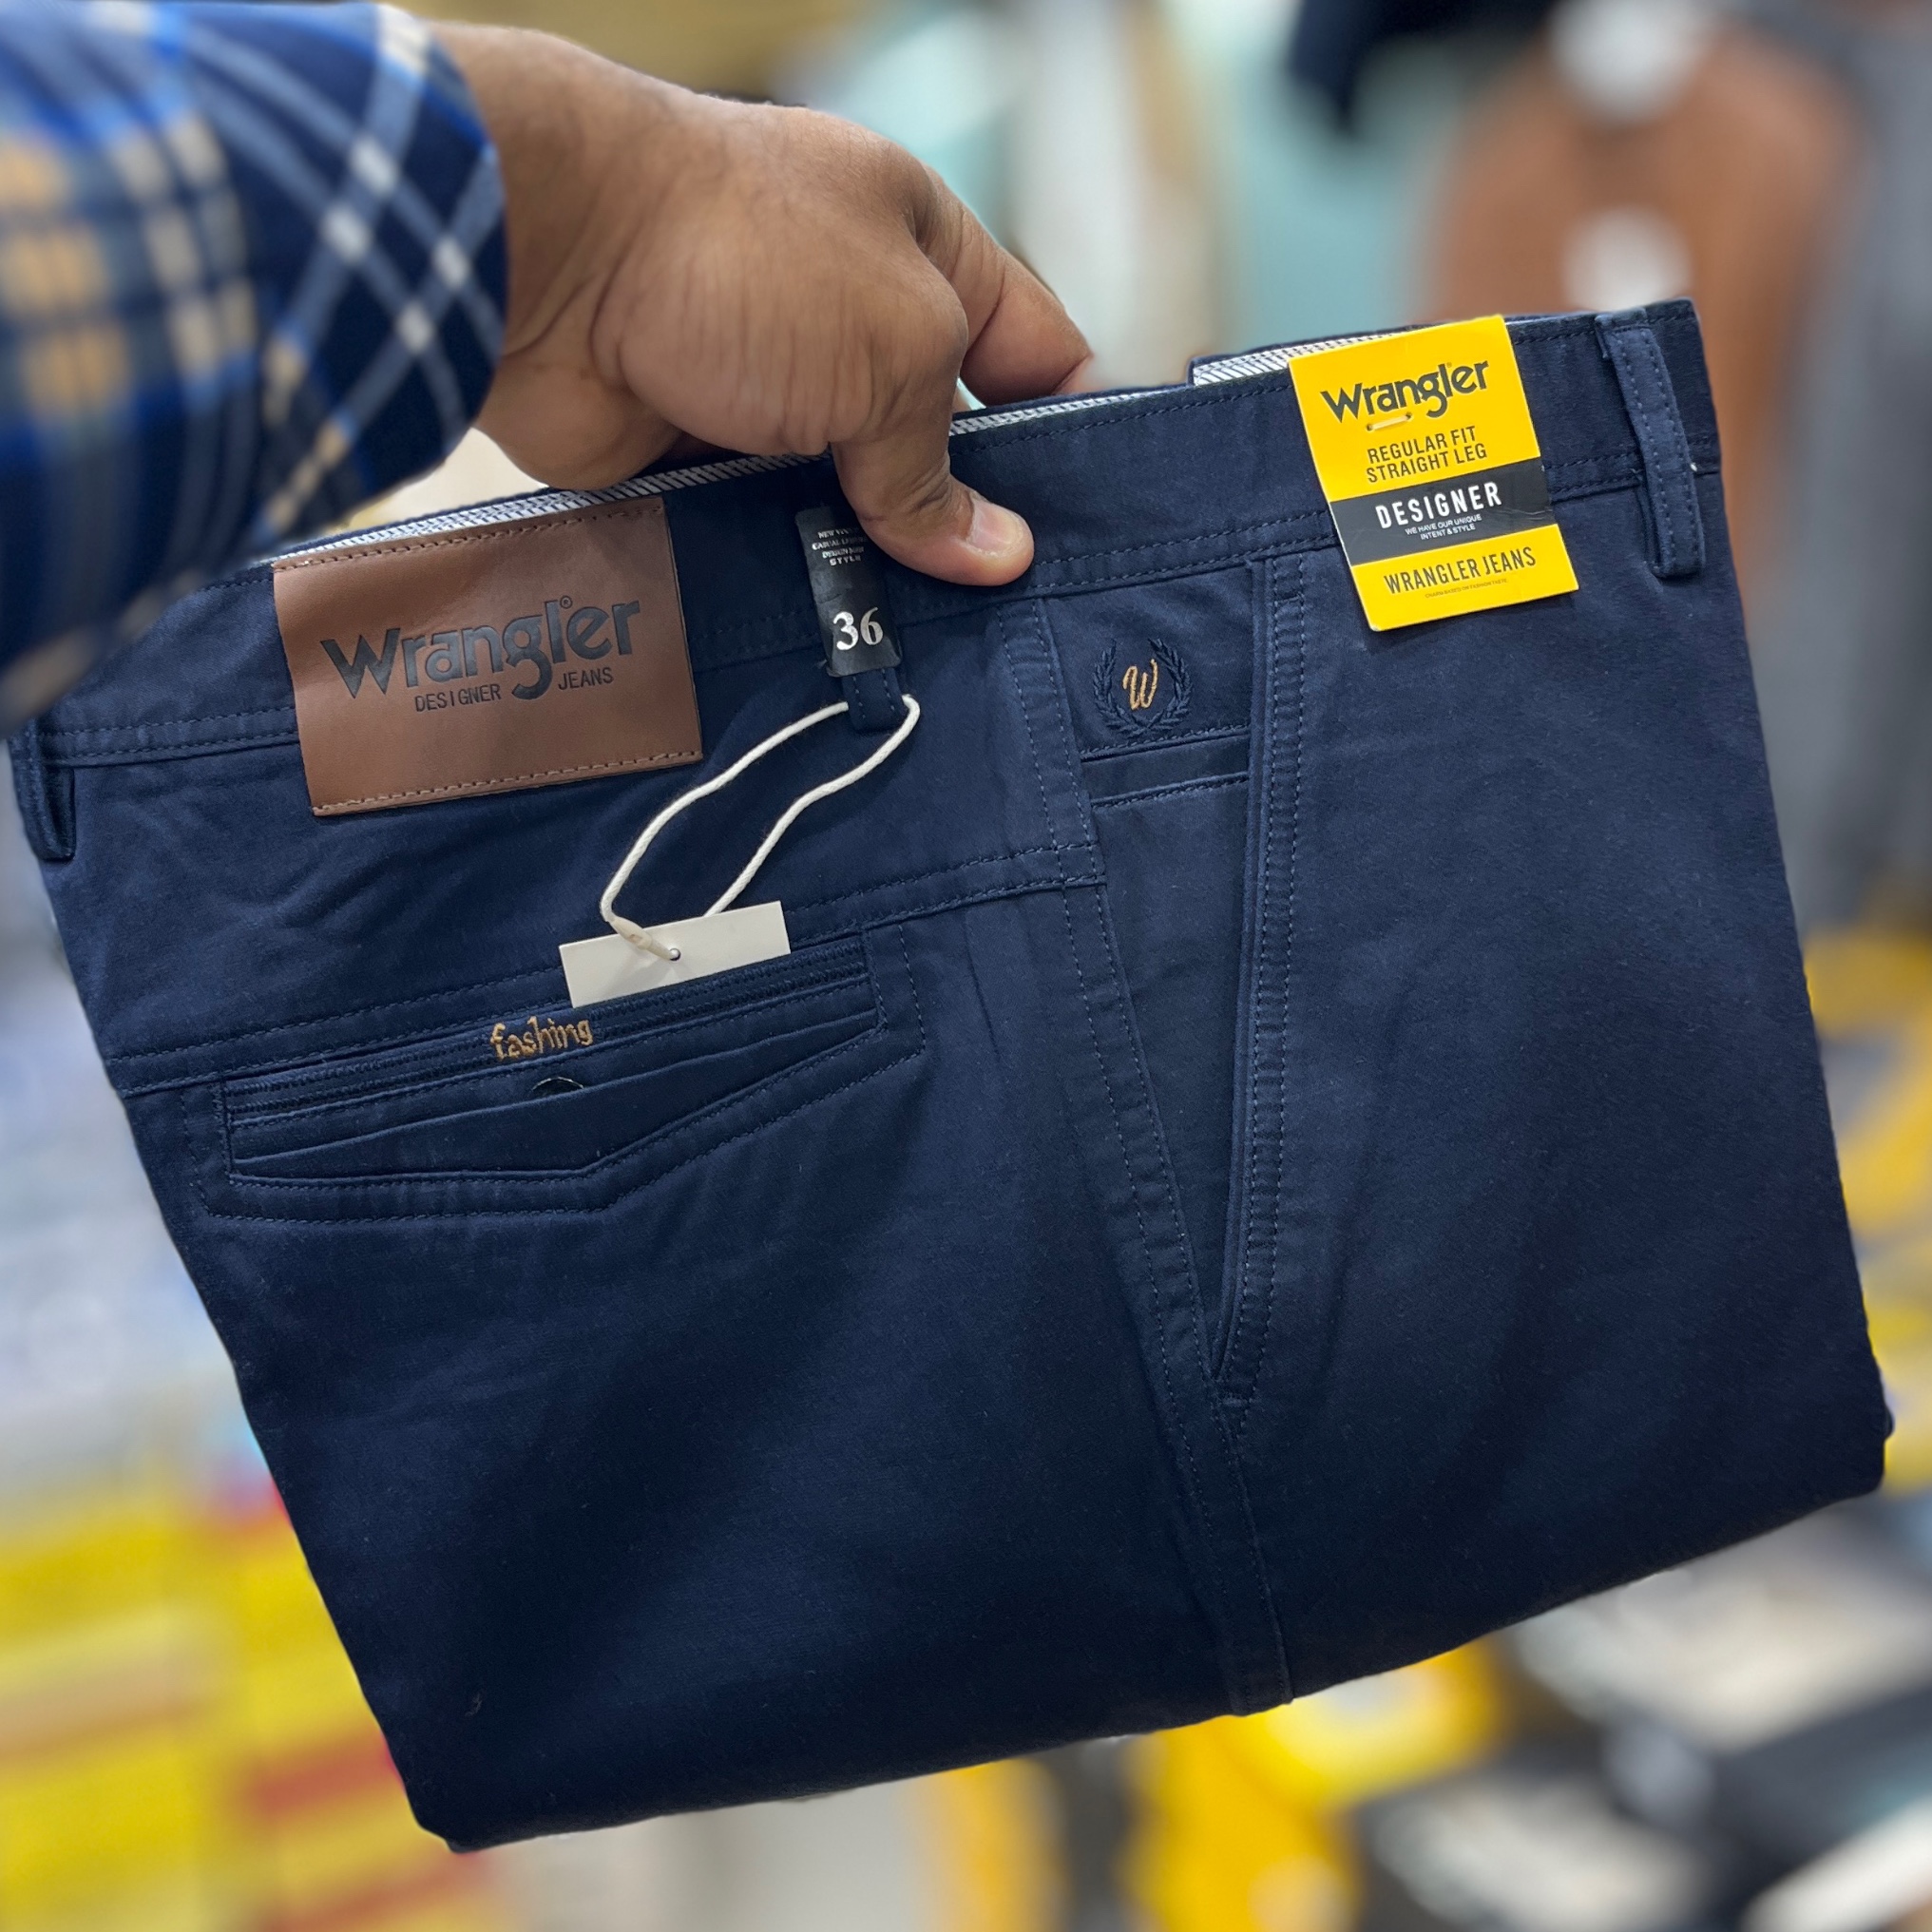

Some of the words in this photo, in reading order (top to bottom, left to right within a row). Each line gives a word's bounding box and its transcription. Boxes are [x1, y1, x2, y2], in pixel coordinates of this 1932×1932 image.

[1320, 360, 1489, 424] Wrangler
[1367, 451, 1449, 483] STRAIGHT
[1454, 443, 1488, 465] LEG
[1368, 432, 1448, 464] REGULAR
[1450, 426, 1476, 446] FIT
[1375, 481, 1502, 529] DESIGNER
[1405, 526, 1418, 535] WE
[1418, 523, 1438, 532] HAVE
[1438, 520, 1454, 529] OUR
[1454, 514, 1482, 526] UNIQUE
[1420, 529, 1446, 541] INTENT
[1452, 523, 1476, 534] STYLE
[1384, 559, 1482, 595] WRANGLER
[1482, 546, 1537, 576] JEANS
[320, 600, 641, 700] Wrangler
[832, 606, 884, 651] 36
[414, 683, 503, 713] DESIGNER
[558, 666, 615, 691] JEANS
[1122, 659, 1157, 711] W
